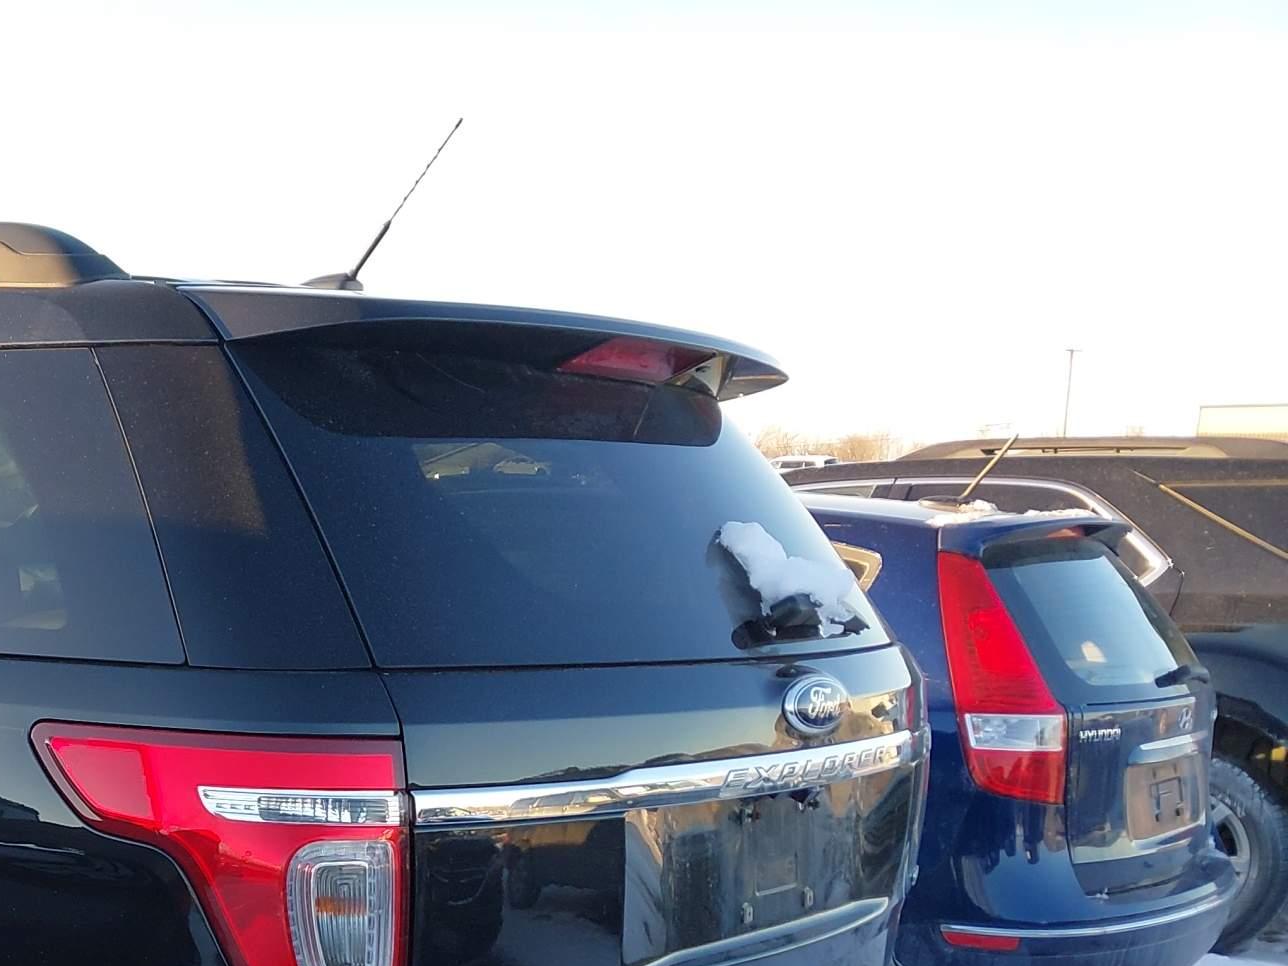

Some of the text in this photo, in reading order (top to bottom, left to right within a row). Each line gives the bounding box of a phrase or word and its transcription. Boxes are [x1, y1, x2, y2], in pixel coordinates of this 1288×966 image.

[808, 686, 842, 718] Ford
[1078, 727, 1122, 744] HYUNDAI
[723, 744, 888, 789] EXPLORER
